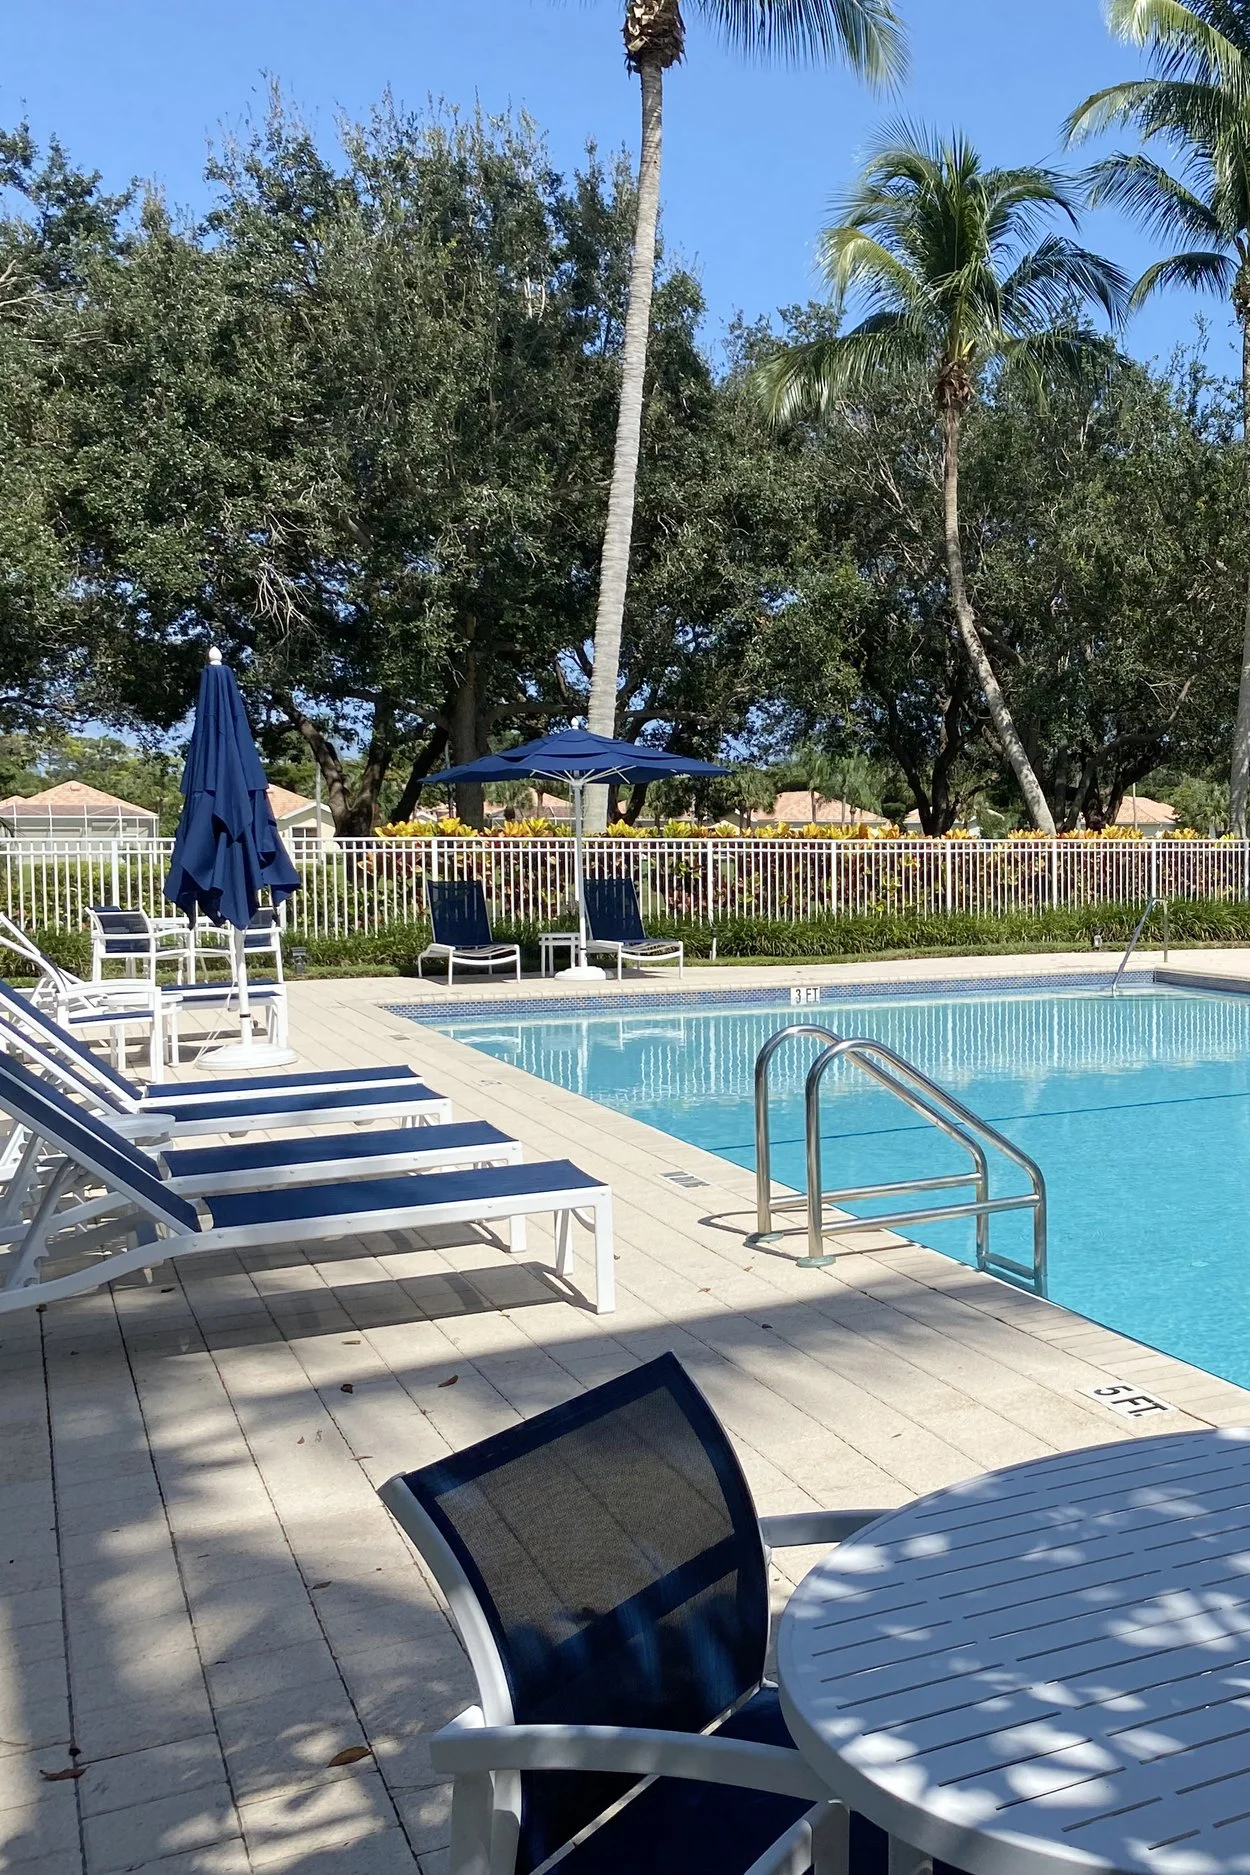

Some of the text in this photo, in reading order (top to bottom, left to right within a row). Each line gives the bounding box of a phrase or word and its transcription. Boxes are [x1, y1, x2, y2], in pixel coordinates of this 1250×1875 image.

[795, 987, 819, 1004] 3 FT
[1093, 1385, 1133, 1396] 5
